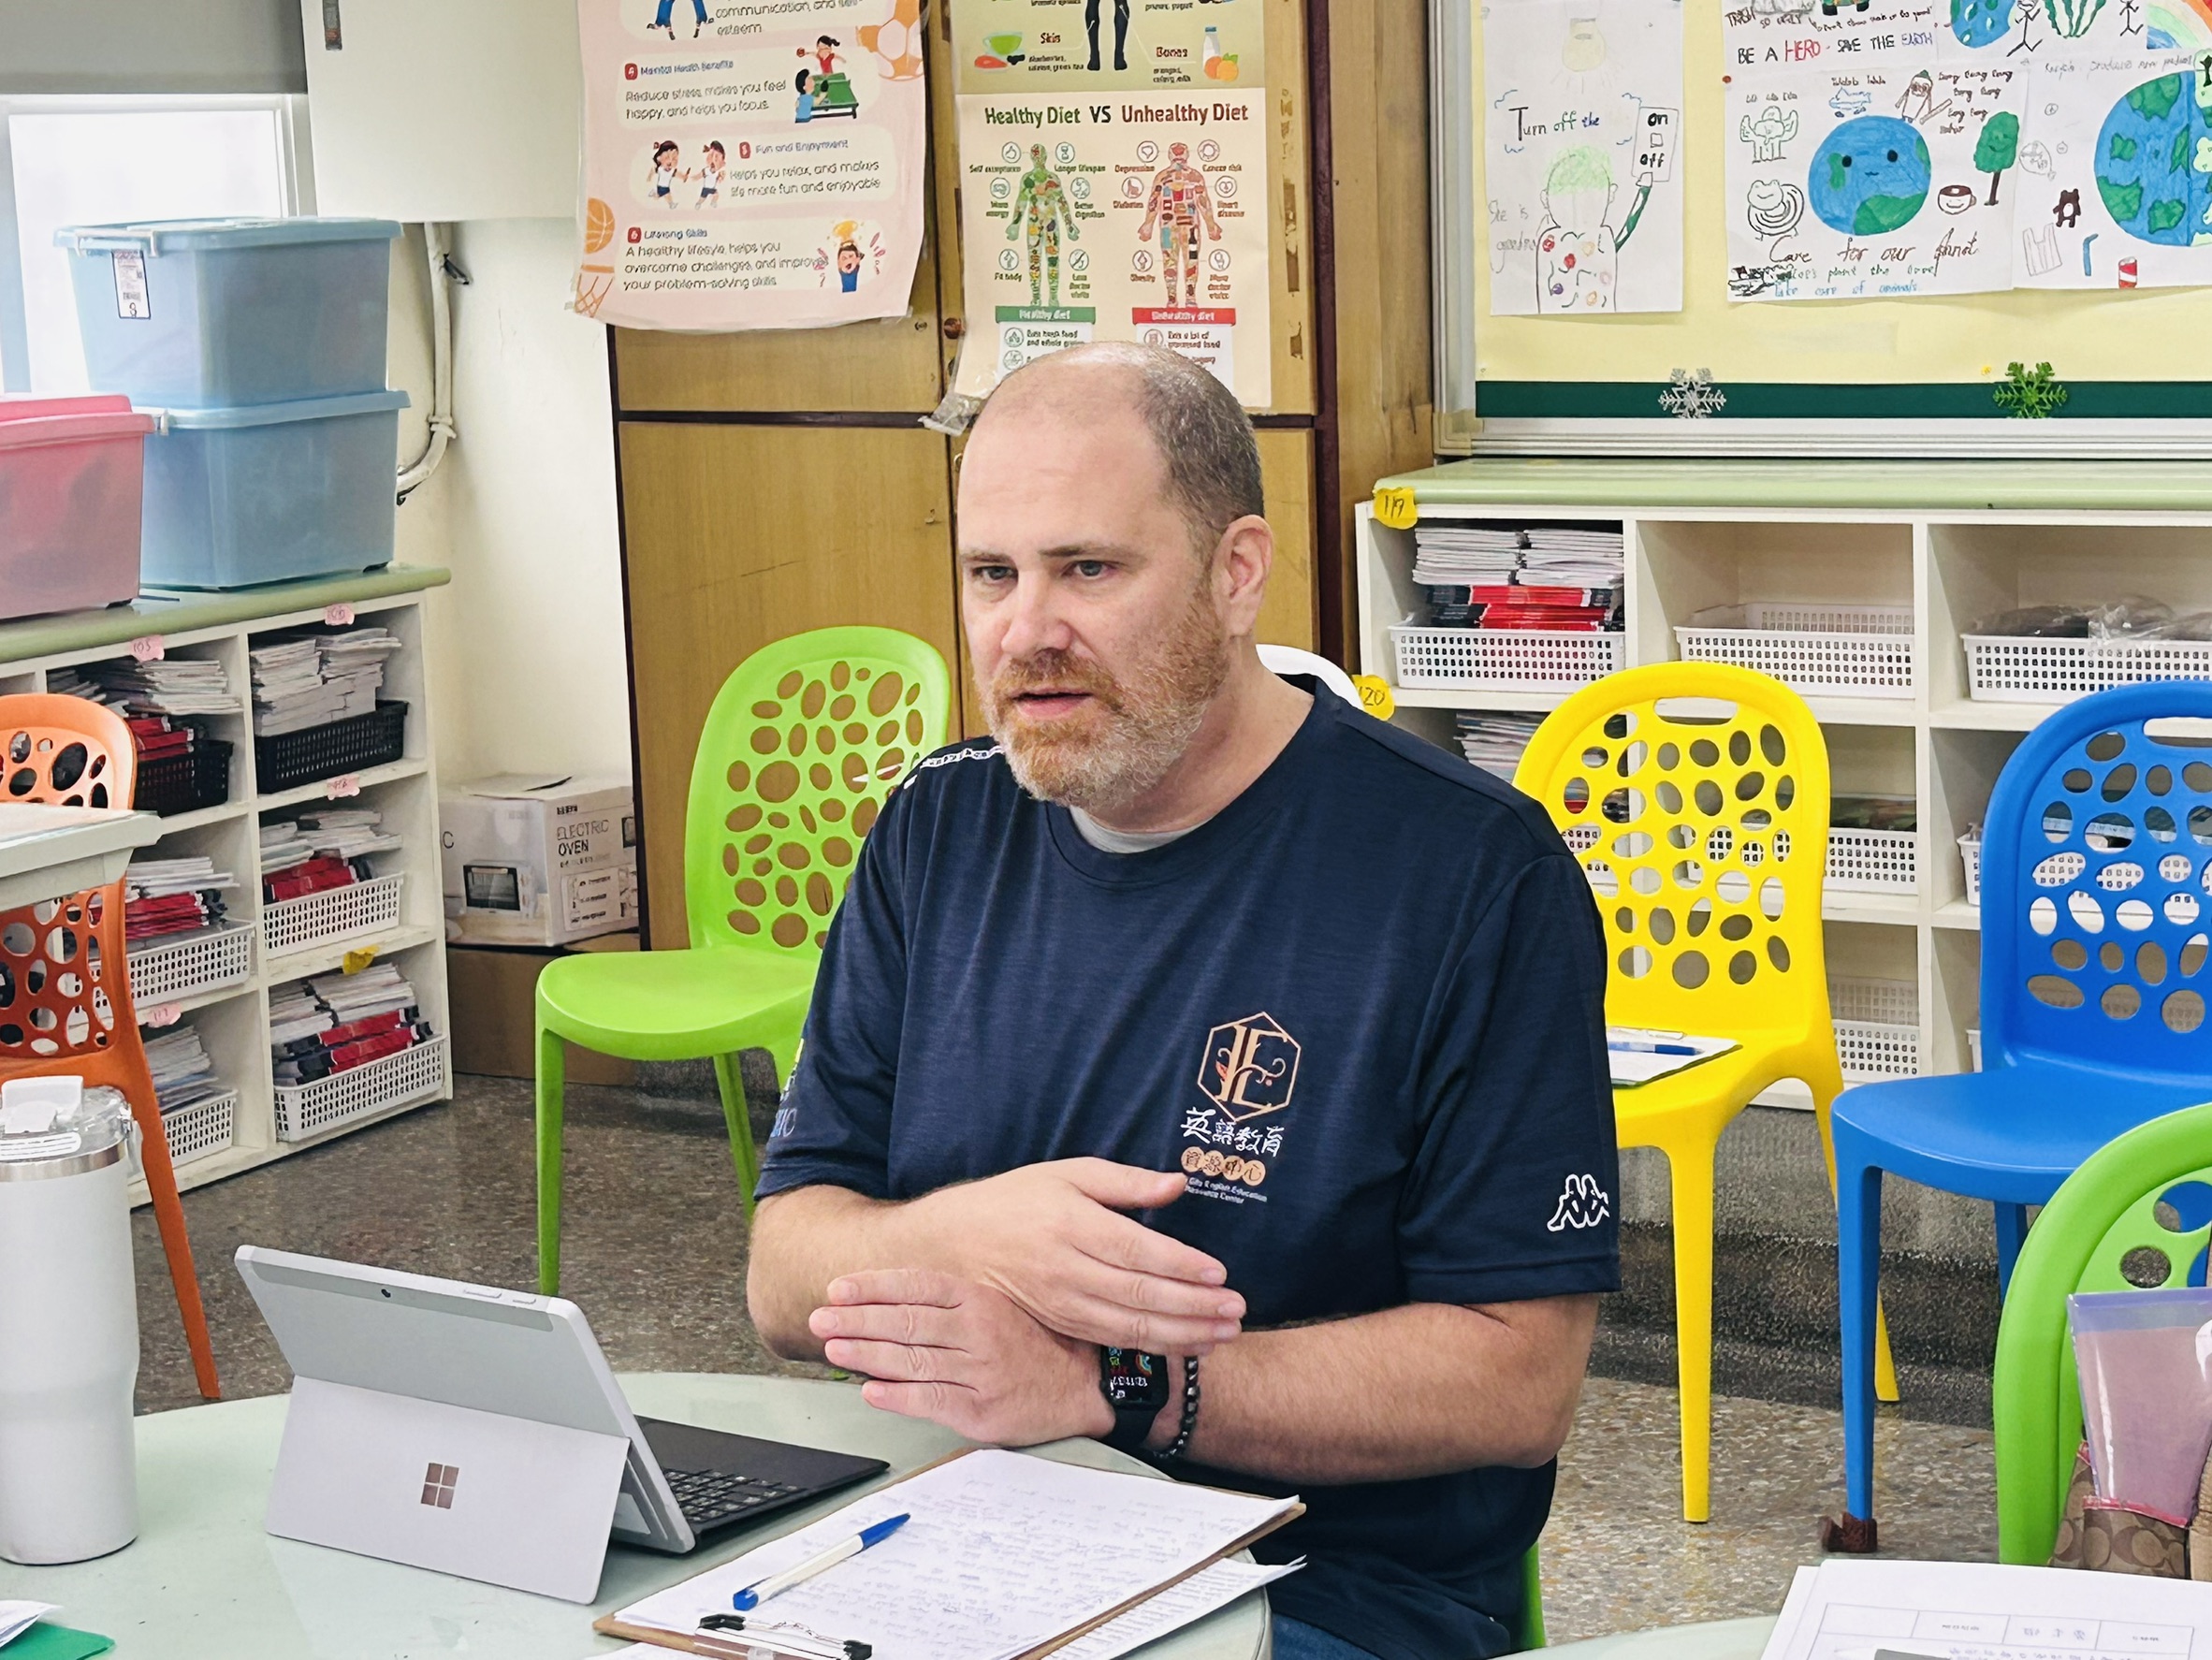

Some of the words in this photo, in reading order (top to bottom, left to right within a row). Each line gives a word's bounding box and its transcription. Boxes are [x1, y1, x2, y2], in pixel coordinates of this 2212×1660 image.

[1738, 47, 1755, 65] BE
[1765, 47, 1778, 62] A
[1784, 39, 1822, 63] HERO
[1871, 34, 1896, 51] THE
[984, 107, 1042, 128] Healthy
[1047, 106, 1081, 124] Diet
[1089, 105, 1112, 124] VS
[1122, 104, 1207, 125] Unhealthy
[1213, 103, 1249, 121] Diet
[1508, 106, 1548, 141] Turn
[1553, 110, 1578, 132] off
[814, 163, 837, 175] and
[801, 182, 824, 193] and
[627, 249, 634, 257] A
[760, 242, 780, 254] you
[1769, 235, 1813, 263] Care
[1837, 237, 1869, 263] for
[1881, 245, 1916, 262] our
[755, 259, 776, 269] and
[558, 839, 589, 856] OVEN
[1181, 1107, 1285, 1158] 英語教育
